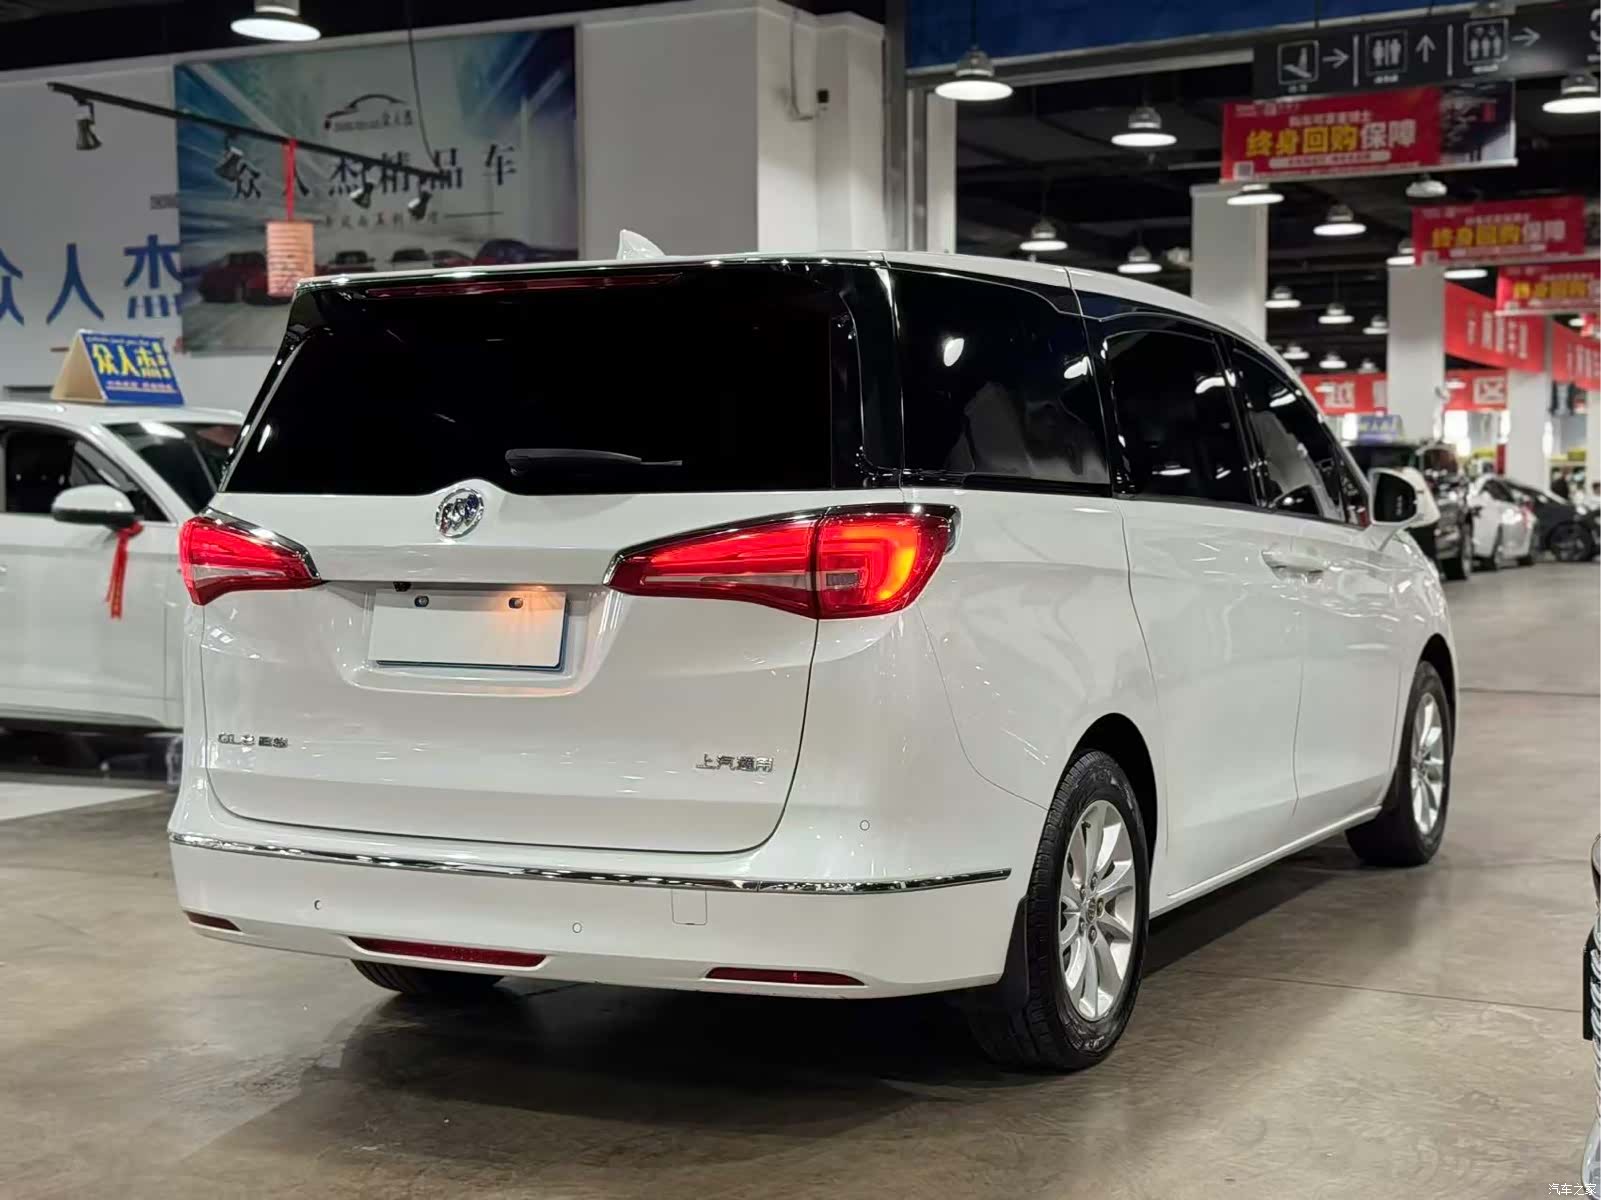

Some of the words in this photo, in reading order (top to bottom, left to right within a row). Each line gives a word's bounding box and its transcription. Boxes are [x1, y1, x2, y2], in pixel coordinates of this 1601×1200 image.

[1245, 118, 1417, 158] 终身回购保障
[696, 753, 774, 773] 上汽通用
